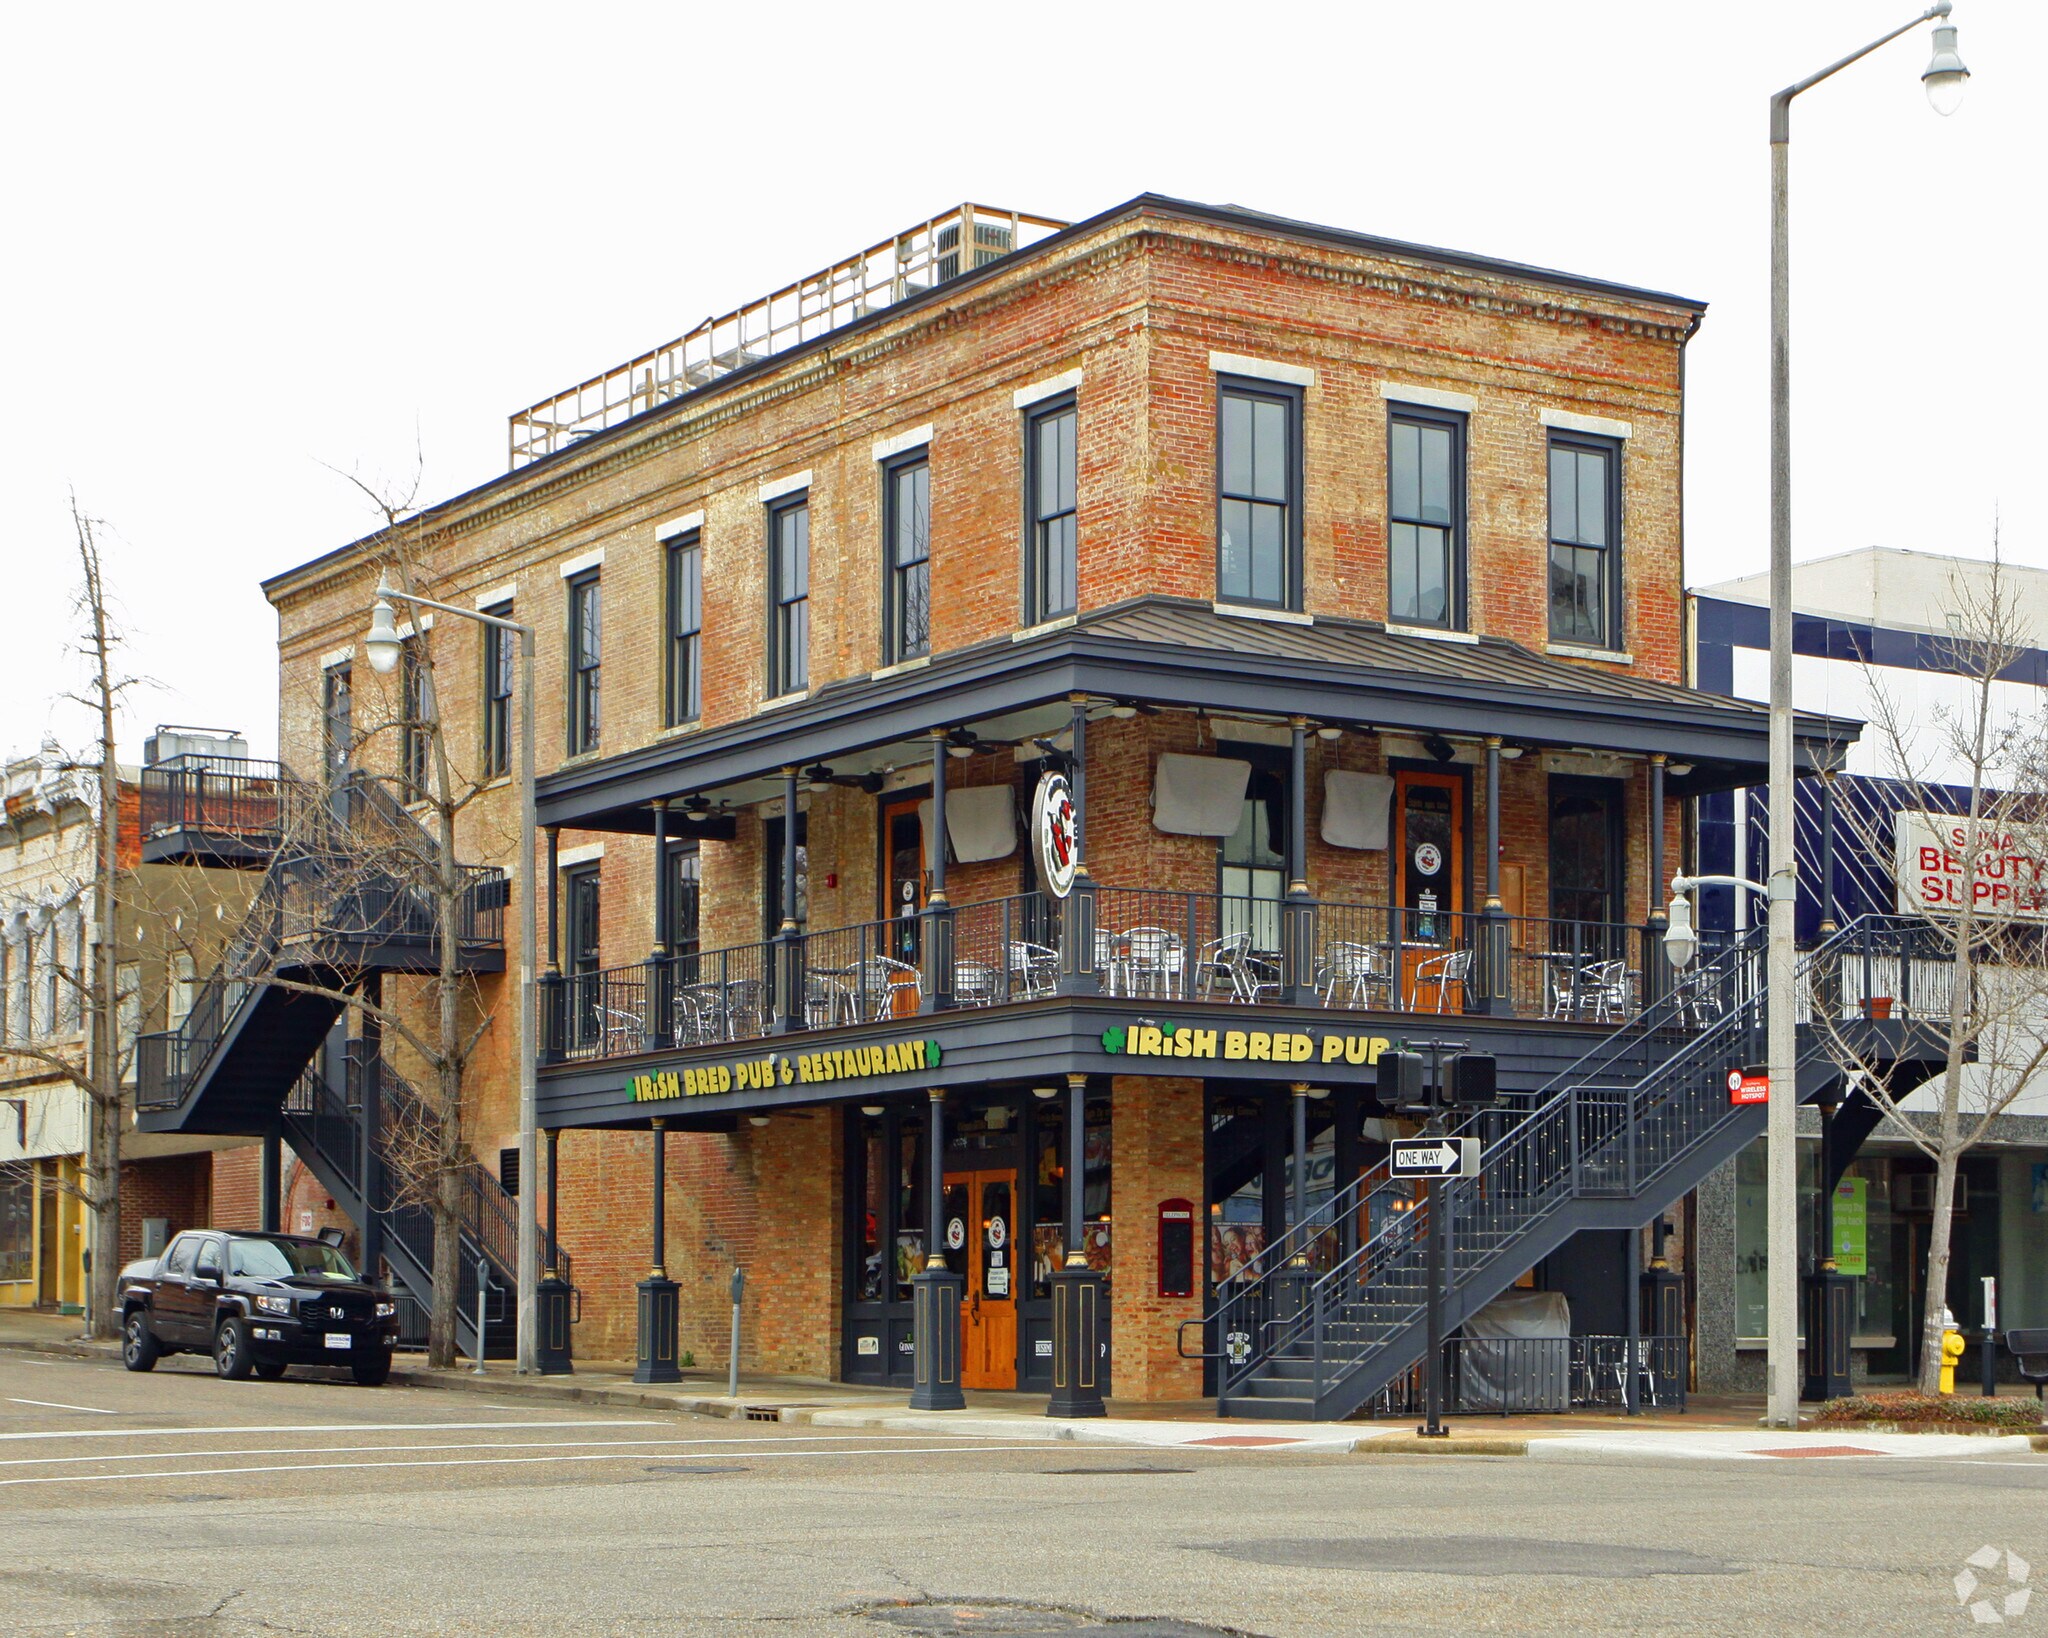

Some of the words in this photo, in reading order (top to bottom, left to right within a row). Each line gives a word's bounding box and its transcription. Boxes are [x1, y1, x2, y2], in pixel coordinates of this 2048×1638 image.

[1921, 876, 2047, 911] SUPPLY
[1224, 1031, 1313, 1062] BRED
[684, 1065, 731, 1096] BRED
[735, 1060, 776, 1089] PUB
[780, 1058, 794, 1085] &
[798, 1040, 925, 1083] RESTAURANT
[1741, 1085, 1766, 1093] WIRELESS
[1399, 1151, 1418, 1165] ONE
[1421, 1150, 1441, 1165] WAY
